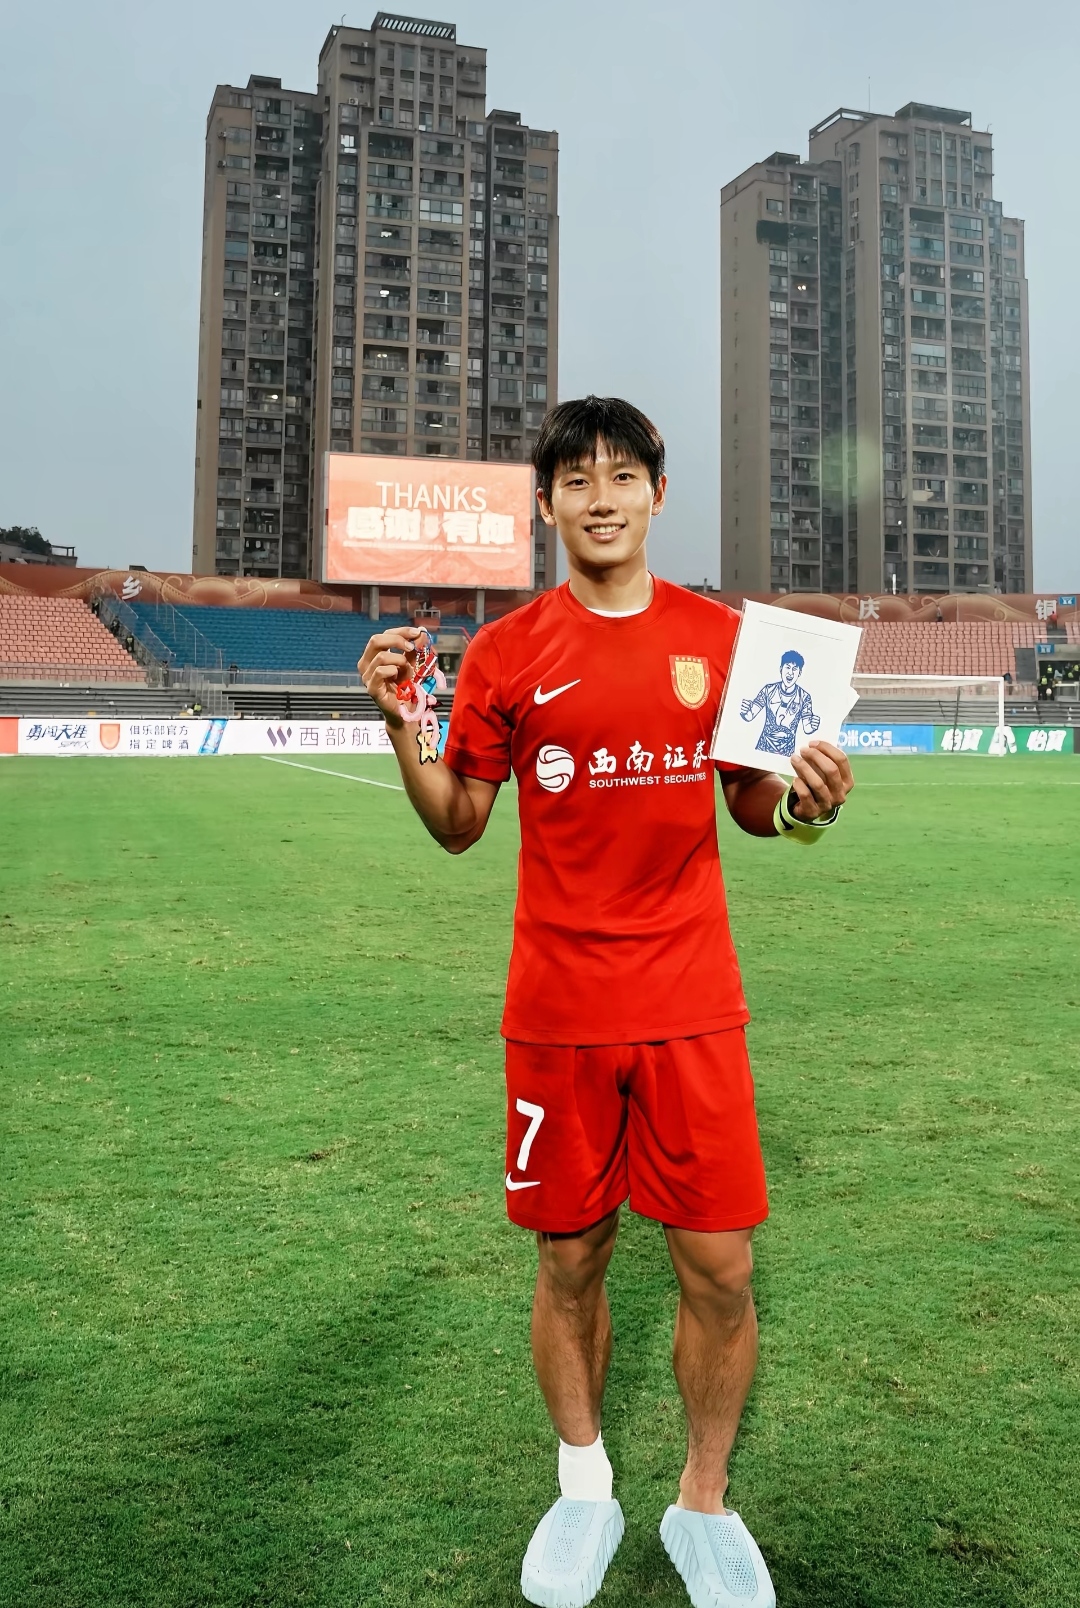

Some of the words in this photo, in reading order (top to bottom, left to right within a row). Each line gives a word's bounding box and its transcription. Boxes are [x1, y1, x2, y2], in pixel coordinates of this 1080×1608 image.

[376, 481, 487, 512] THANKS
[858, 599, 881, 620] 庆
[26, 724, 88, 741] 勇闯天涯
[129, 724, 190, 736] 俱乐部官方
[129, 739, 190, 750] 指定啤酒
[589, 775, 661, 789] SOUTHWEST
[663, 771, 707, 784] SECURITIES
[516, 1098, 545, 1172] 7
